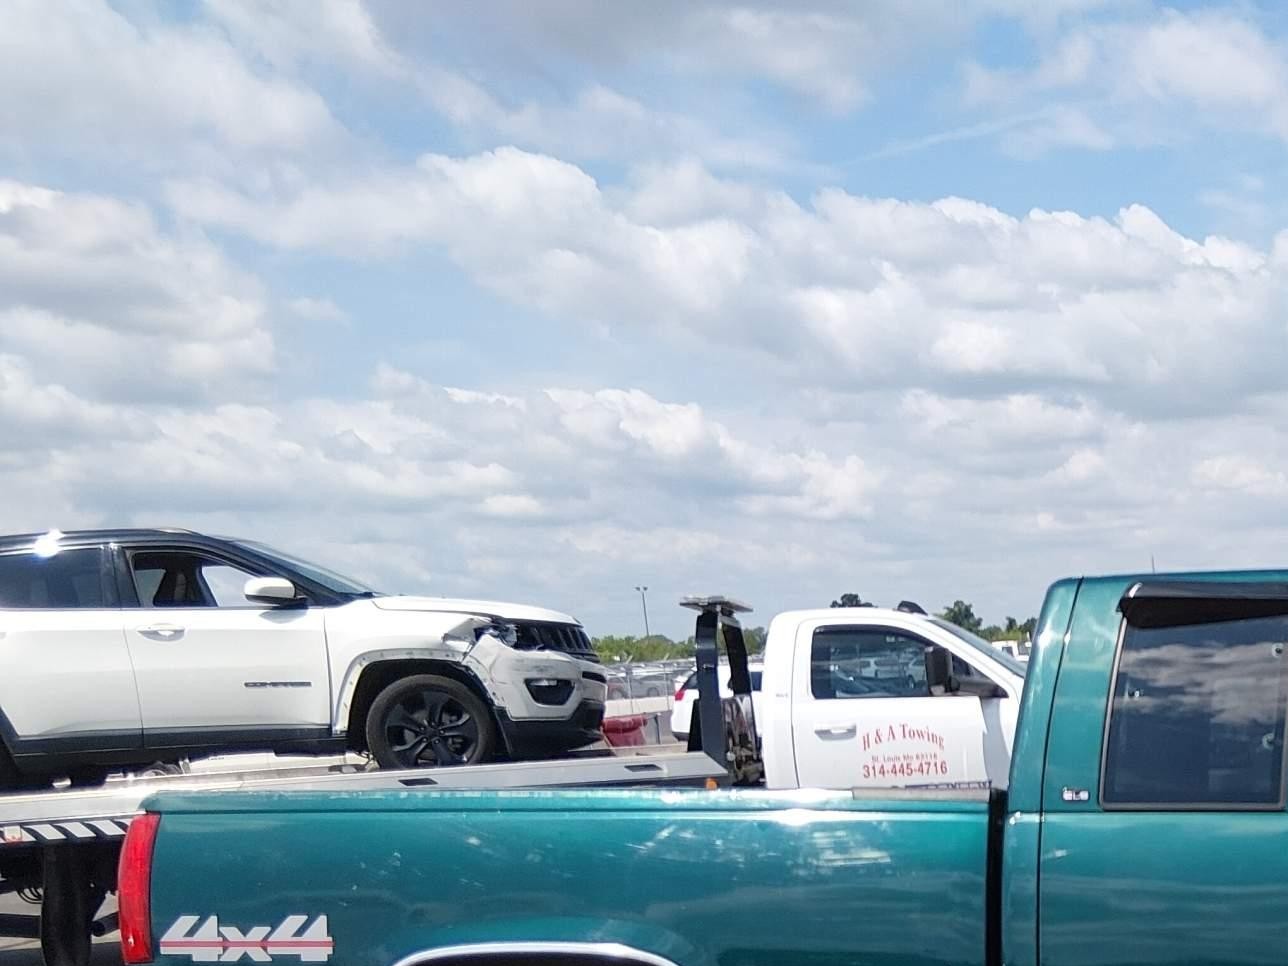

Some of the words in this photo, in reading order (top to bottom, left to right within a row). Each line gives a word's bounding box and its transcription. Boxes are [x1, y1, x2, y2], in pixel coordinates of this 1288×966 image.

[874, 729, 882, 744] &
[887, 725, 896, 741] A
[899, 722, 945, 750] Towing
[863, 760, 948, 779] 314-445-4716
[159, 915, 334, 962] 4x4
